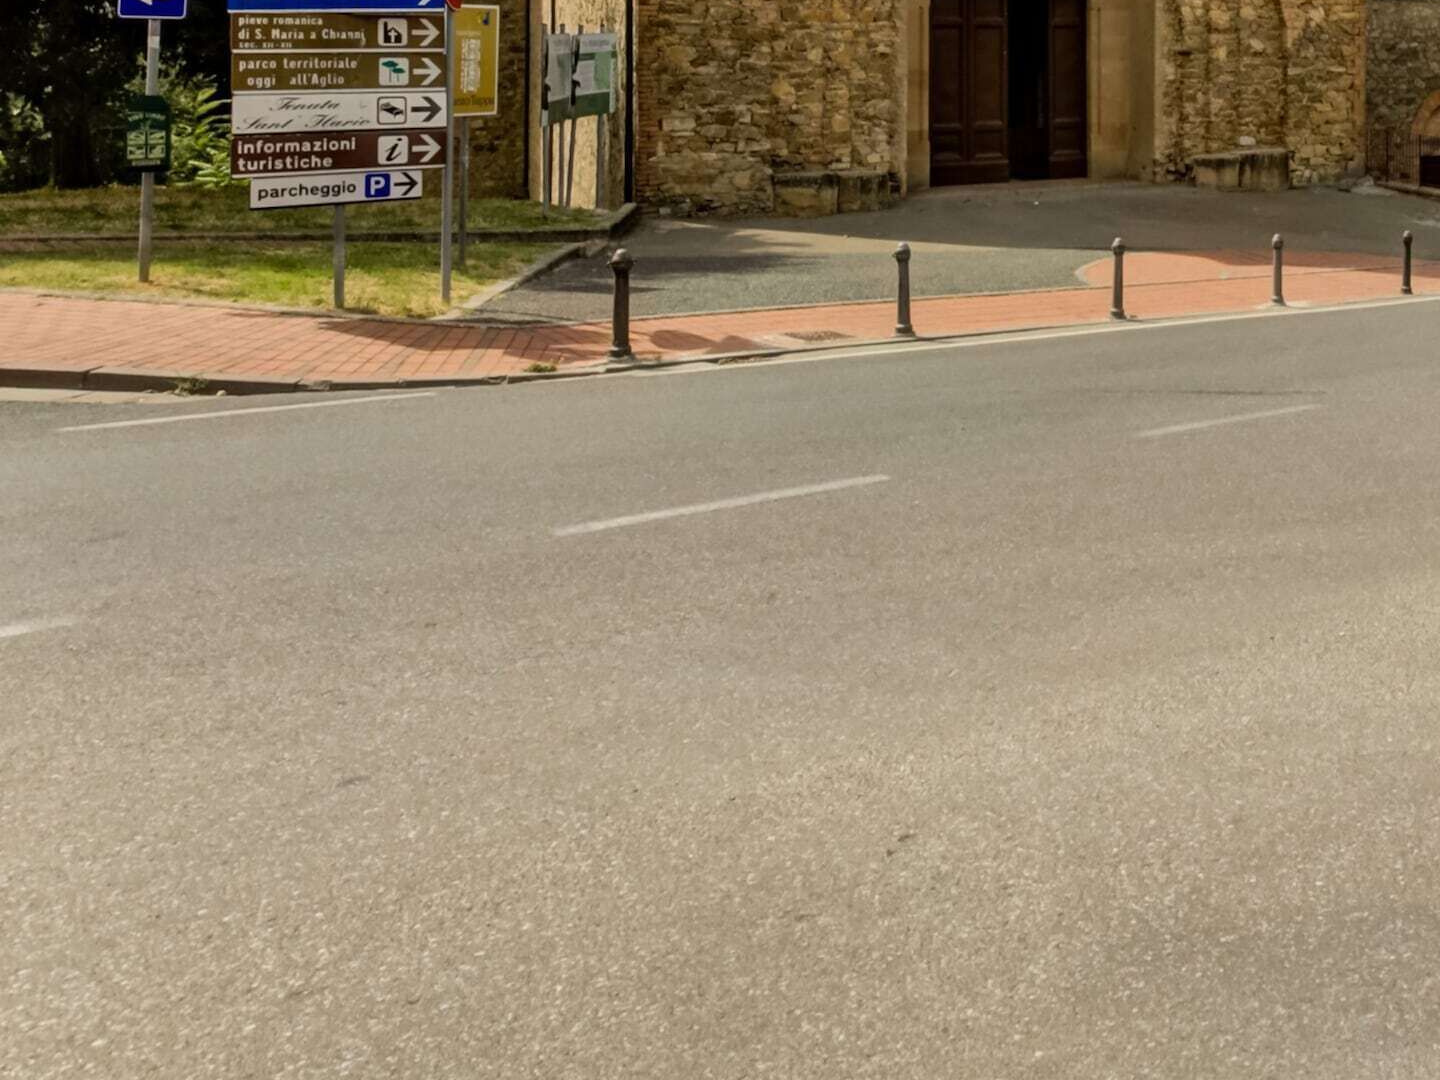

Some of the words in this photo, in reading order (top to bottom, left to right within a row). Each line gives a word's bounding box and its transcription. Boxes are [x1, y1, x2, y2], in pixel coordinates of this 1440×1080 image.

[238, 15, 269, 28] pieve
[273, 16, 323, 26] romanica
[238, 28, 250, 40] di
[255, 28, 266, 40] S.
[271, 28, 304, 40] Maria
[310, 30, 317, 40] a
[239, 58, 277, 72] parco
[283, 56, 358, 69] territoriale
[247, 75, 276, 88] oggi
[289, 72, 345, 88] all'Aglio
[268, 96, 341, 112] Tenuta
[237, 137, 356, 155] informazioni
[237, 154, 333, 171] turistiche
[257, 181, 356, 201] parcheggio
[370, 177, 385, 195] P
